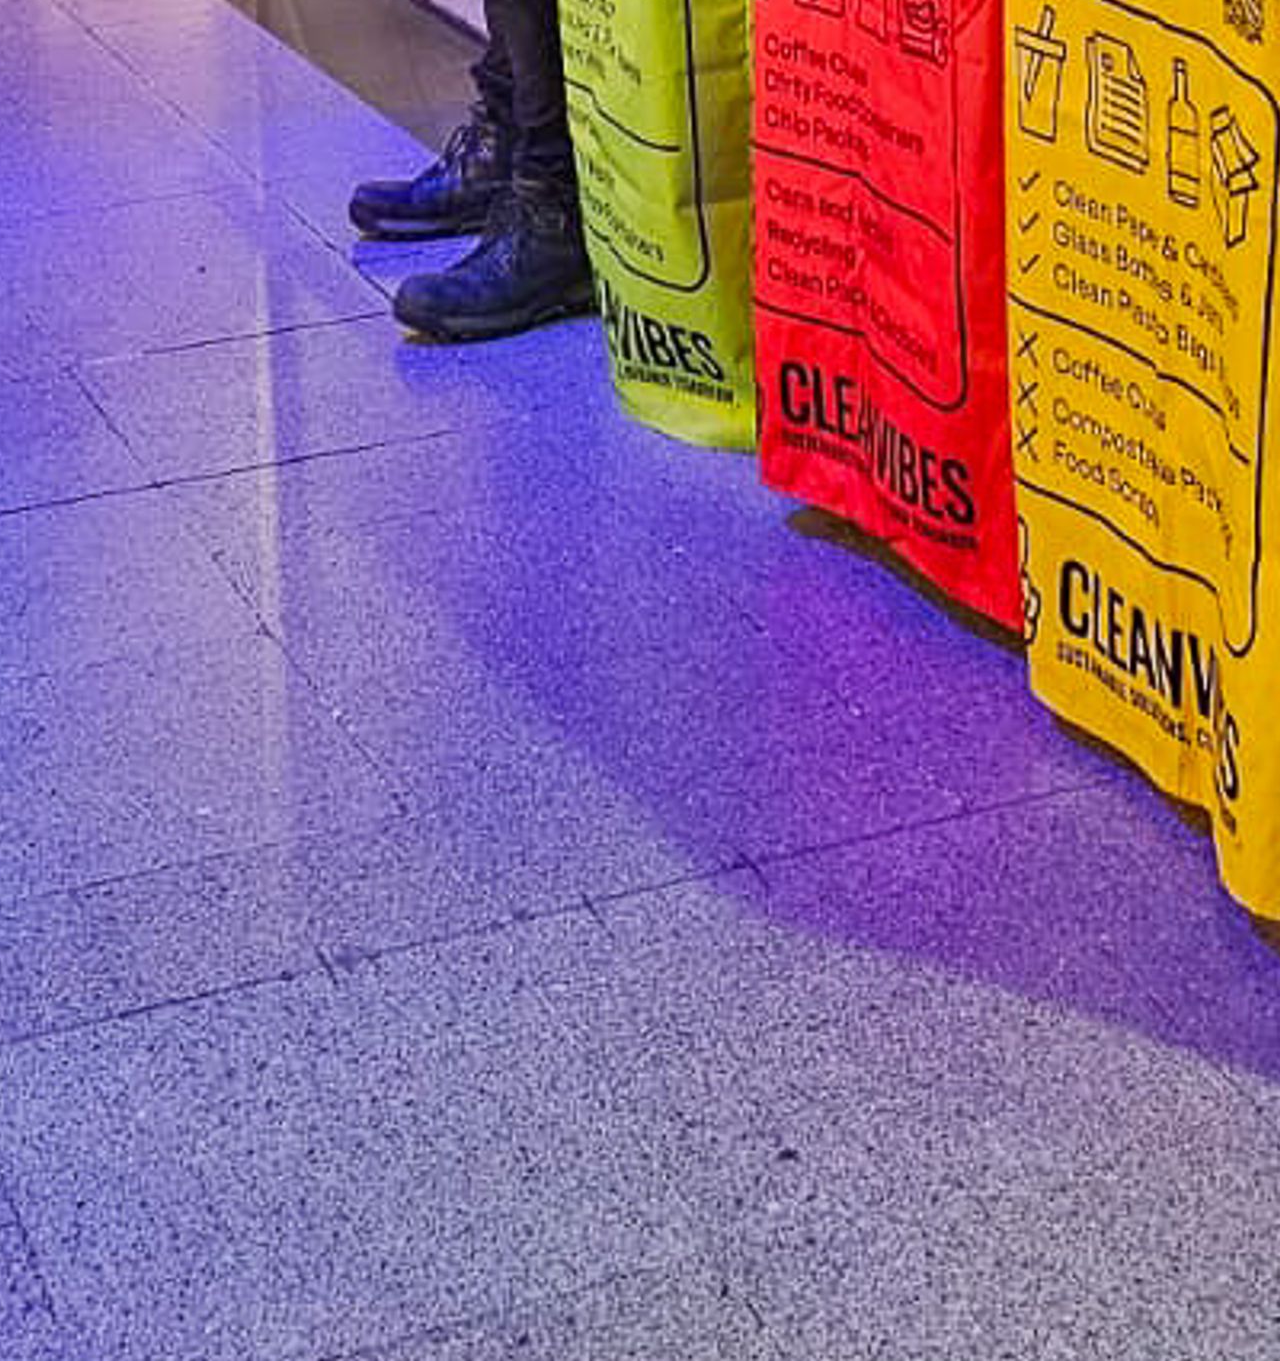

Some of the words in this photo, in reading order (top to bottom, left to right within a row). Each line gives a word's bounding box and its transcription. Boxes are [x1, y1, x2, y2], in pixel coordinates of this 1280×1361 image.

[1053, 180, 1112, 225] Clean
[1053, 221, 1111, 265] Glass
[1053, 263, 1112, 307] Clean
[1053, 347, 1124, 402] Coffee
[1054, 439, 1105, 486] Food
